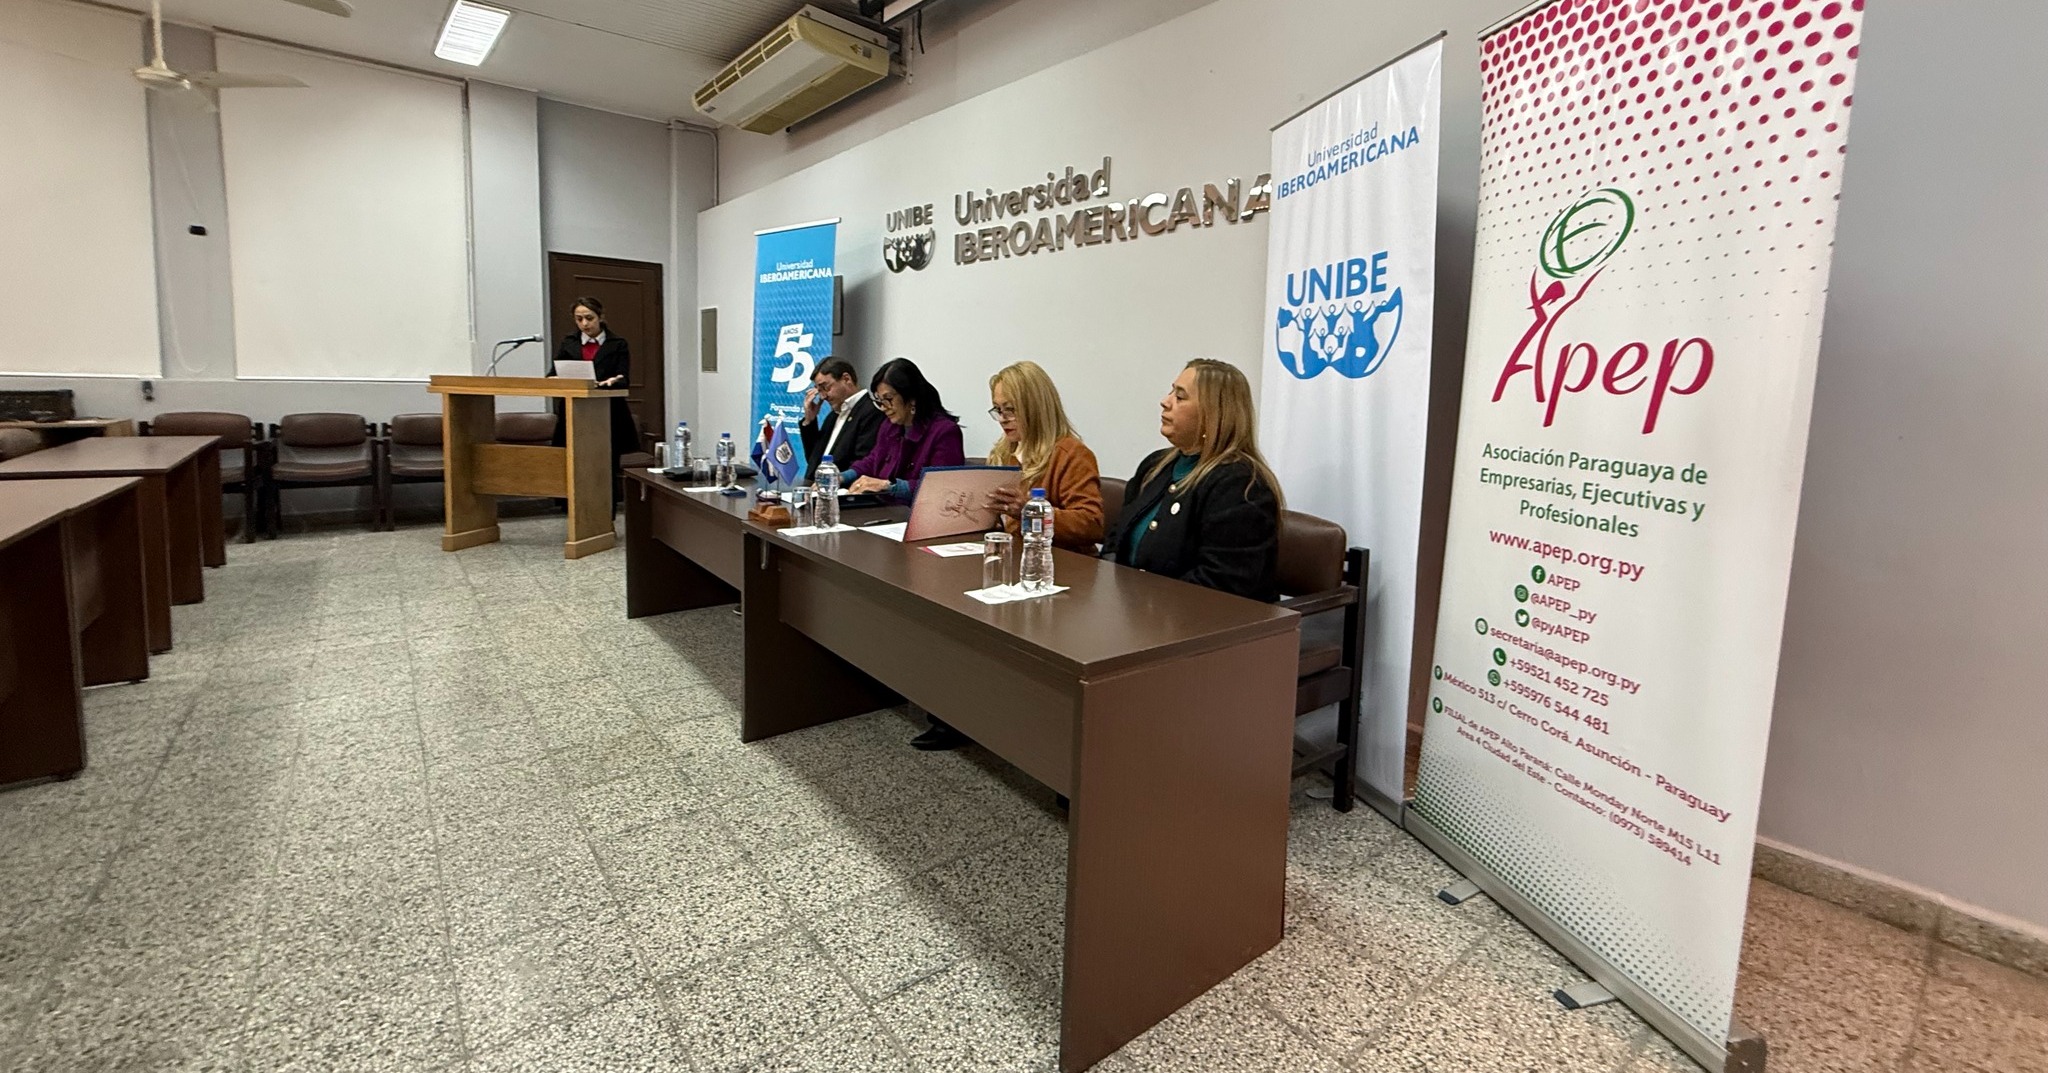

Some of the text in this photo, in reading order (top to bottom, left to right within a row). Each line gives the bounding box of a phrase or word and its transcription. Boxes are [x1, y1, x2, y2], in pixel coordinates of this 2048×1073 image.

[1277, 126, 1420, 200] IBEROAMERICANA
[1307, 121, 1378, 168] Universidad
[954, 156, 1112, 226] Universidad
[886, 203, 934, 233] UNIBE
[953, 173, 1272, 265] IBEROAMERICANA
[760, 267, 832, 284] IBEROAMERICANA
[776, 258, 814, 271] Universidad
[1287, 251, 1388, 307] UNIBE
[1491, 266, 1714, 434] Apep
[1482, 443, 1708, 485] Asociación Paraguaya de
[1480, 468, 1706, 522] Empresarias, Ejecutivas y
[1519, 500, 1639, 537] Profesionales
[1489, 530, 1645, 582] www.apep.org.py
[1546, 573, 1581, 592] APEP
[1530, 593, 1597, 624] @APEP_py
[1531, 617, 1591, 645] @pyAPEP
[1490, 626, 1641, 694] secretaria@apep.org.py
[1509, 657, 1609, 707] +59521 452 725
[1503, 679, 1610, 735] +595976 544 481
[1478, 688, 1496, 705] 513
[1508, 703, 1538, 726] Cerro
[1575, 737, 1641, 777] Asunción
[1655, 773, 1732, 823] Paraguay
[1481, 740, 1511, 764] Ciudad
[1526, 766, 1546, 784] Este
[1554, 767, 1581, 788] Calle
[1583, 782, 1629, 814] Monday
[1631, 807, 1666, 834] Norte
[1667, 827, 1694, 850] M15
[1696, 843, 1721, 866] L11
